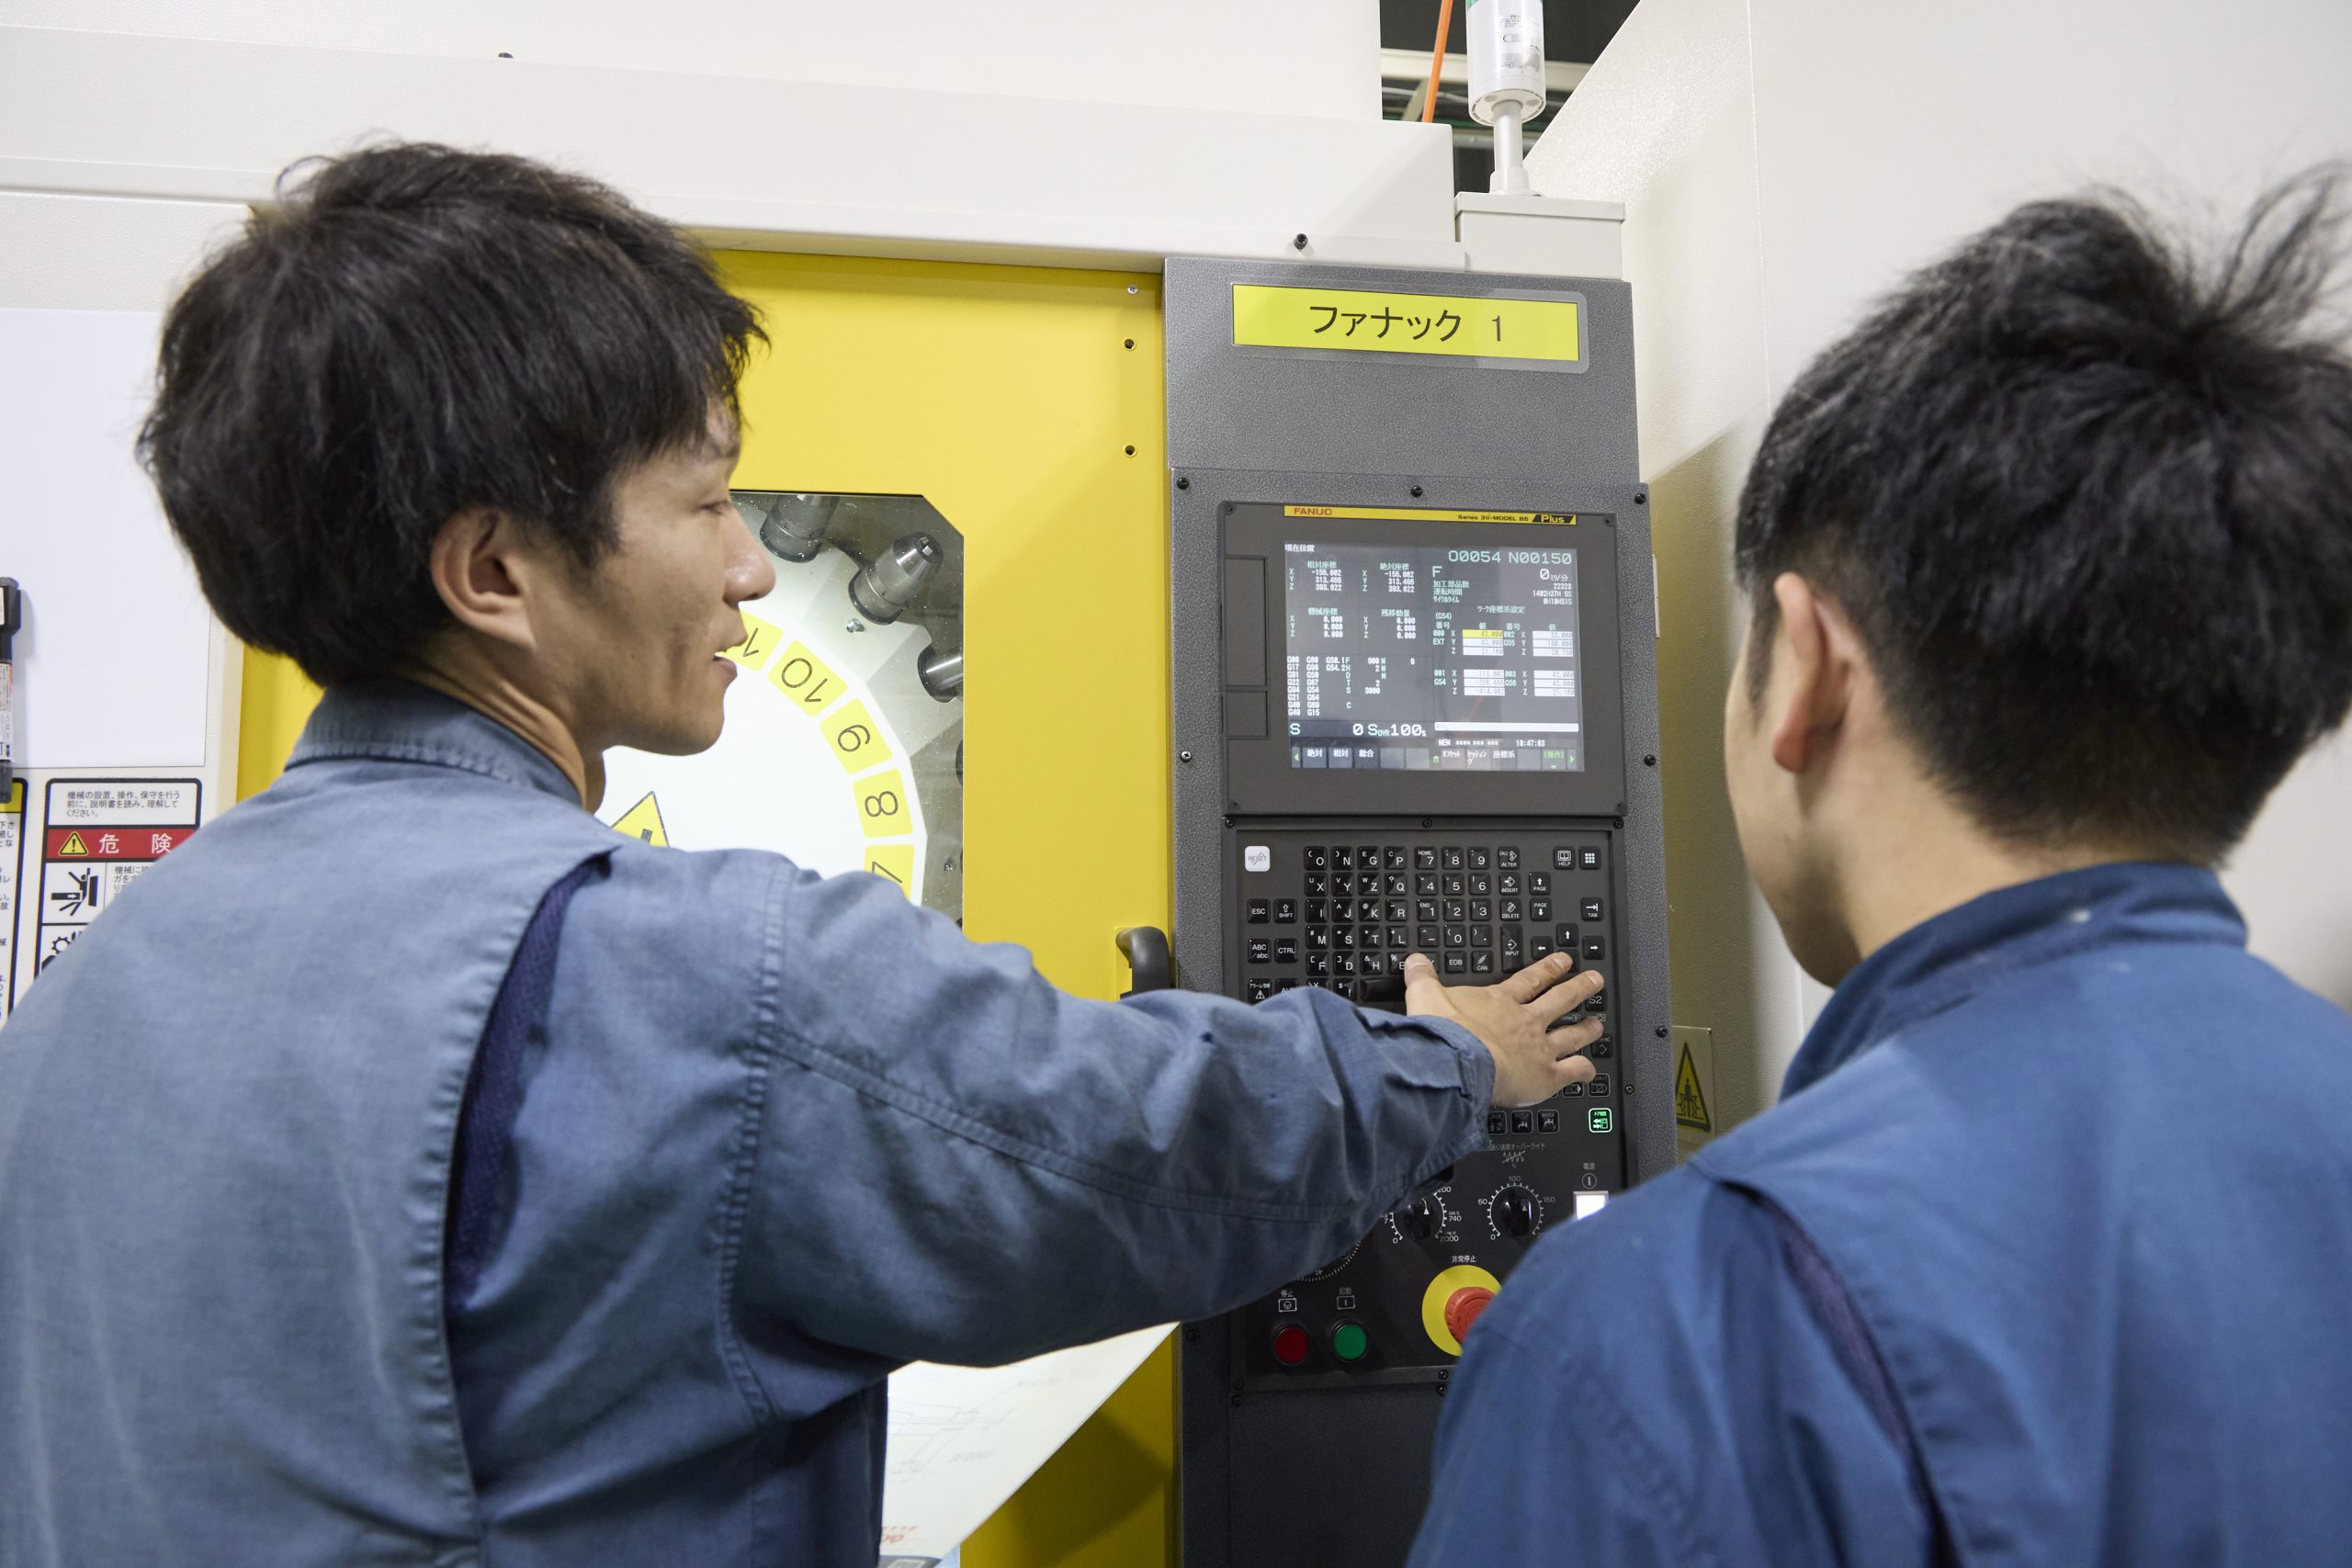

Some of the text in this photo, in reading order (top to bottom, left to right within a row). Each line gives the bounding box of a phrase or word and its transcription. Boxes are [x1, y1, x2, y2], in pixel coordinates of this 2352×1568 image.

[1310, 305, 1502, 343] ファナック 1
[1541, 515, 1565, 523] Plus
[1284, 544, 1315, 552] 現在位置
[1509, 552, 1572, 564] N00150
[1307, 560, 1337, 569] 相対座標
[1380, 563, 1409, 571] 絶対座標
[1432, 565, 1549, 580] F 0
[781, 658, 828, 703] 10
[1290, 723, 1300, 735] S
[1353, 723, 1363, 735] 0
[1307, 749, 1323, 757] 絶対
[1333, 749, 1348, 757] 相対
[1359, 750, 1374, 758] 総合
[1493, 750, 1515, 759] 座標系
[67, 791, 181, 800] 機械の設置、操作、保守を行う
[67, 800, 179, 809] 前に、説明書を読み、理解して
[864, 790, 899, 818] 8
[66, 809, 100, 817] ください。
[1343, 857, 1351, 866] N
[1369, 857, 1378, 865] G
[1396, 857, 1403, 866] P
[1427, 857, 1434, 865] 7
[1452, 856, 1459, 865] 8
[1477, 856, 1485, 865] 9
[1317, 883, 1324, 891] X
[1344, 883, 1351, 891] Y
[1370, 883, 1378, 891] Z
[1396, 883, 1405, 892] Q
[1427, 882, 1435, 891] 4
[1453, 882, 1460, 891] 5
[1479, 882, 1486, 891] 6
[1430, 908, 1435, 916] 1
[1453, 908, 1461, 917] 2
[1479, 908, 1487, 916] 3
[1317, 936, 1326, 944] M
[1345, 936, 1352, 944] S
[1372, 936, 1379, 944] T
[1398, 936, 1405, 944] L
[1319, 962, 1326, 970] F
[1346, 962, 1353, 970] D
[1373, 962, 1380, 970] H
